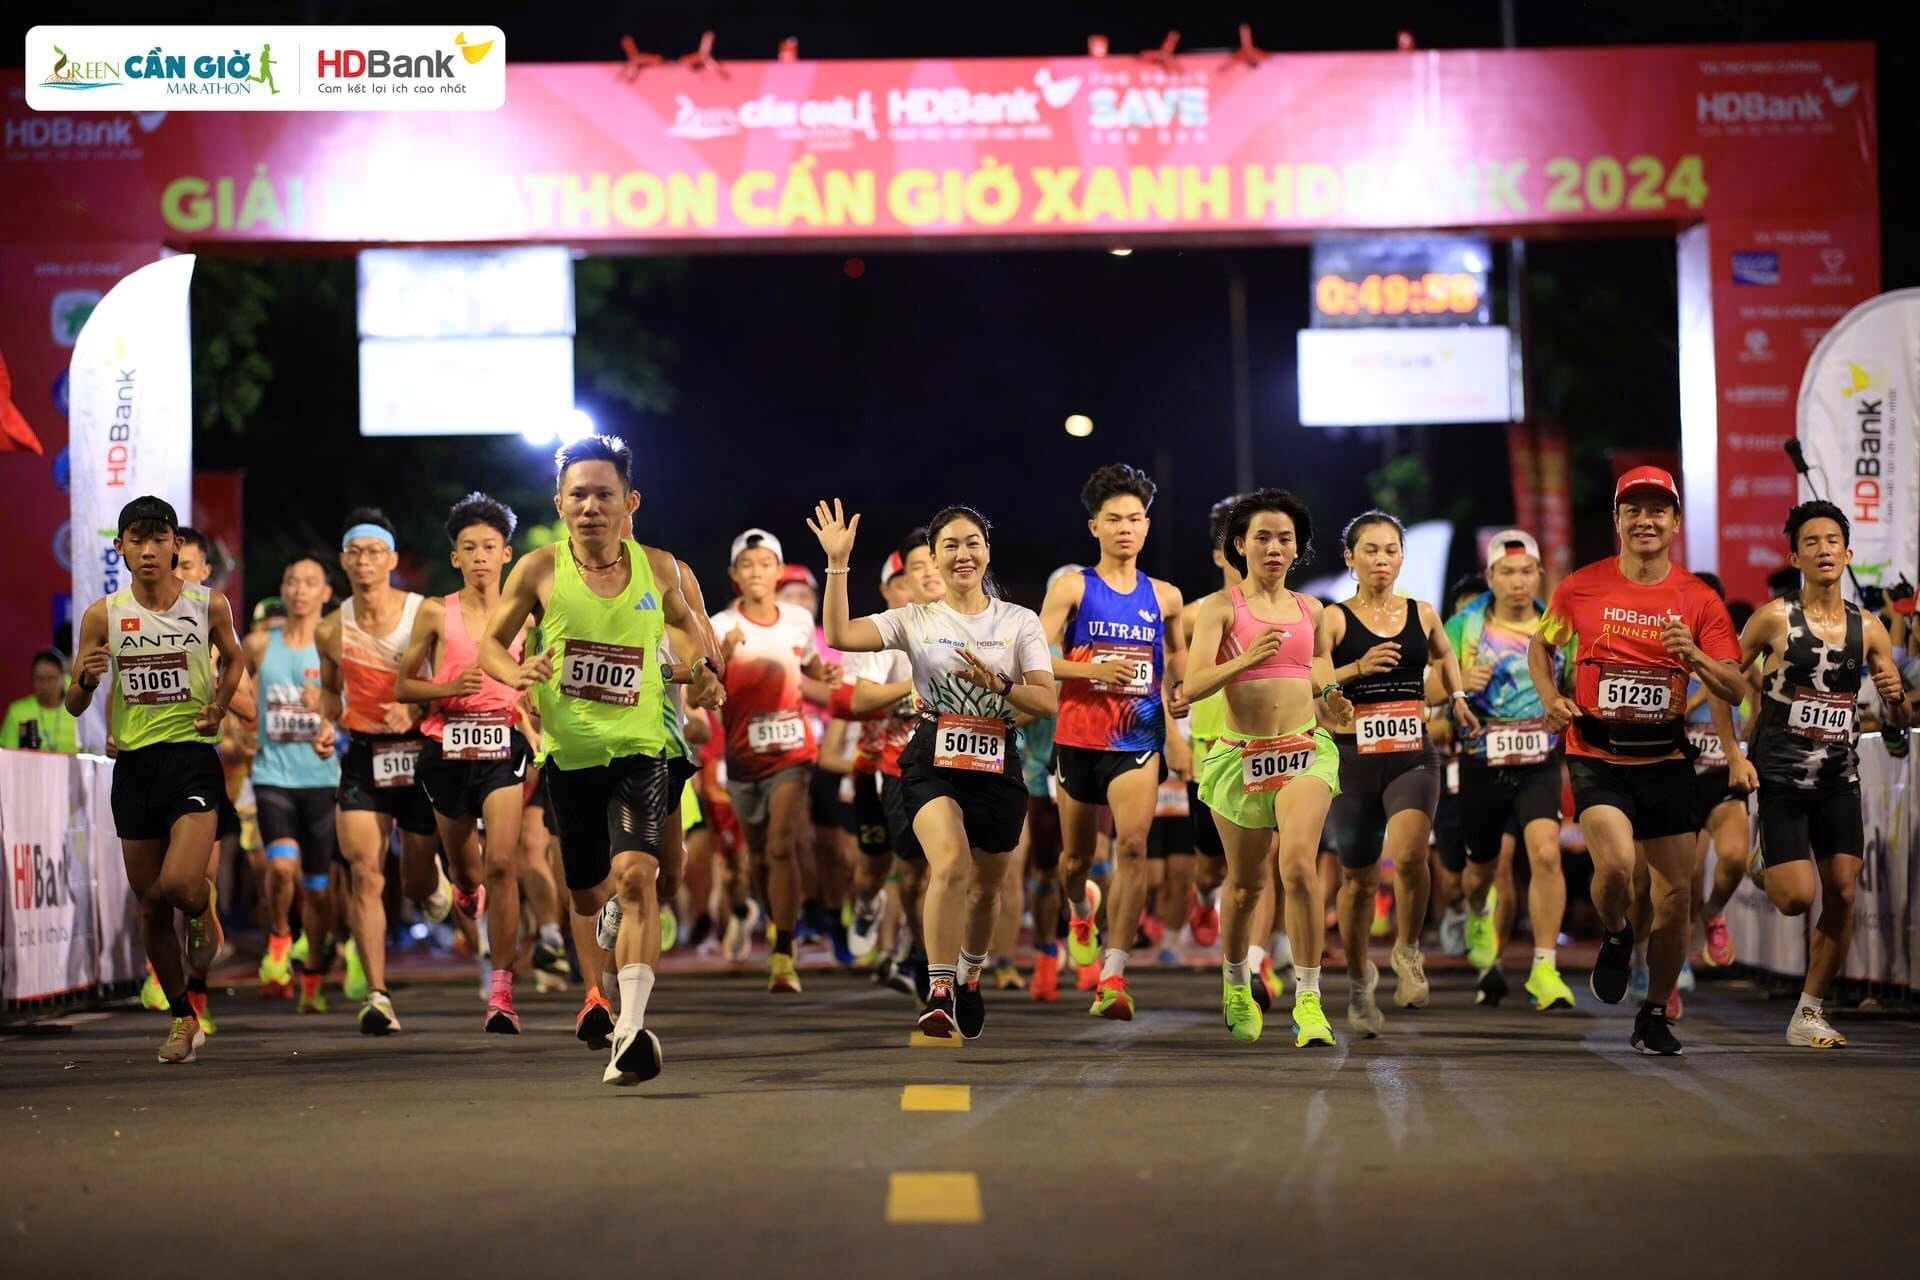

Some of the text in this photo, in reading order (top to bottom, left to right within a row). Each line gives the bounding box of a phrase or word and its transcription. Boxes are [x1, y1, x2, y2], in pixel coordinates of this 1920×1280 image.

[5, 117, 132, 147] HDBank
[889, 157, 1020, 226] GIỜ
[1033, 165, 1227, 226] XANH
[1547, 156, 1708, 212] 2024
[107, 368, 136, 487] HDBank
[1855, 399, 1882, 523] HDBank
[120, 632, 201, 649] ANTA
[128, 670, 180, 691] 51061
[571, 660, 636, 688] 51002
[1608, 683, 1664, 706] 51236
[1363, 718, 1418, 738] 50045
[1800, 706, 1846, 728] 51140
[452, 727, 503, 745] 51050
[944, 732, 999, 756] 50158
[1497, 734, 1541, 752] 51001
[1251, 751, 1309, 777] 50047
